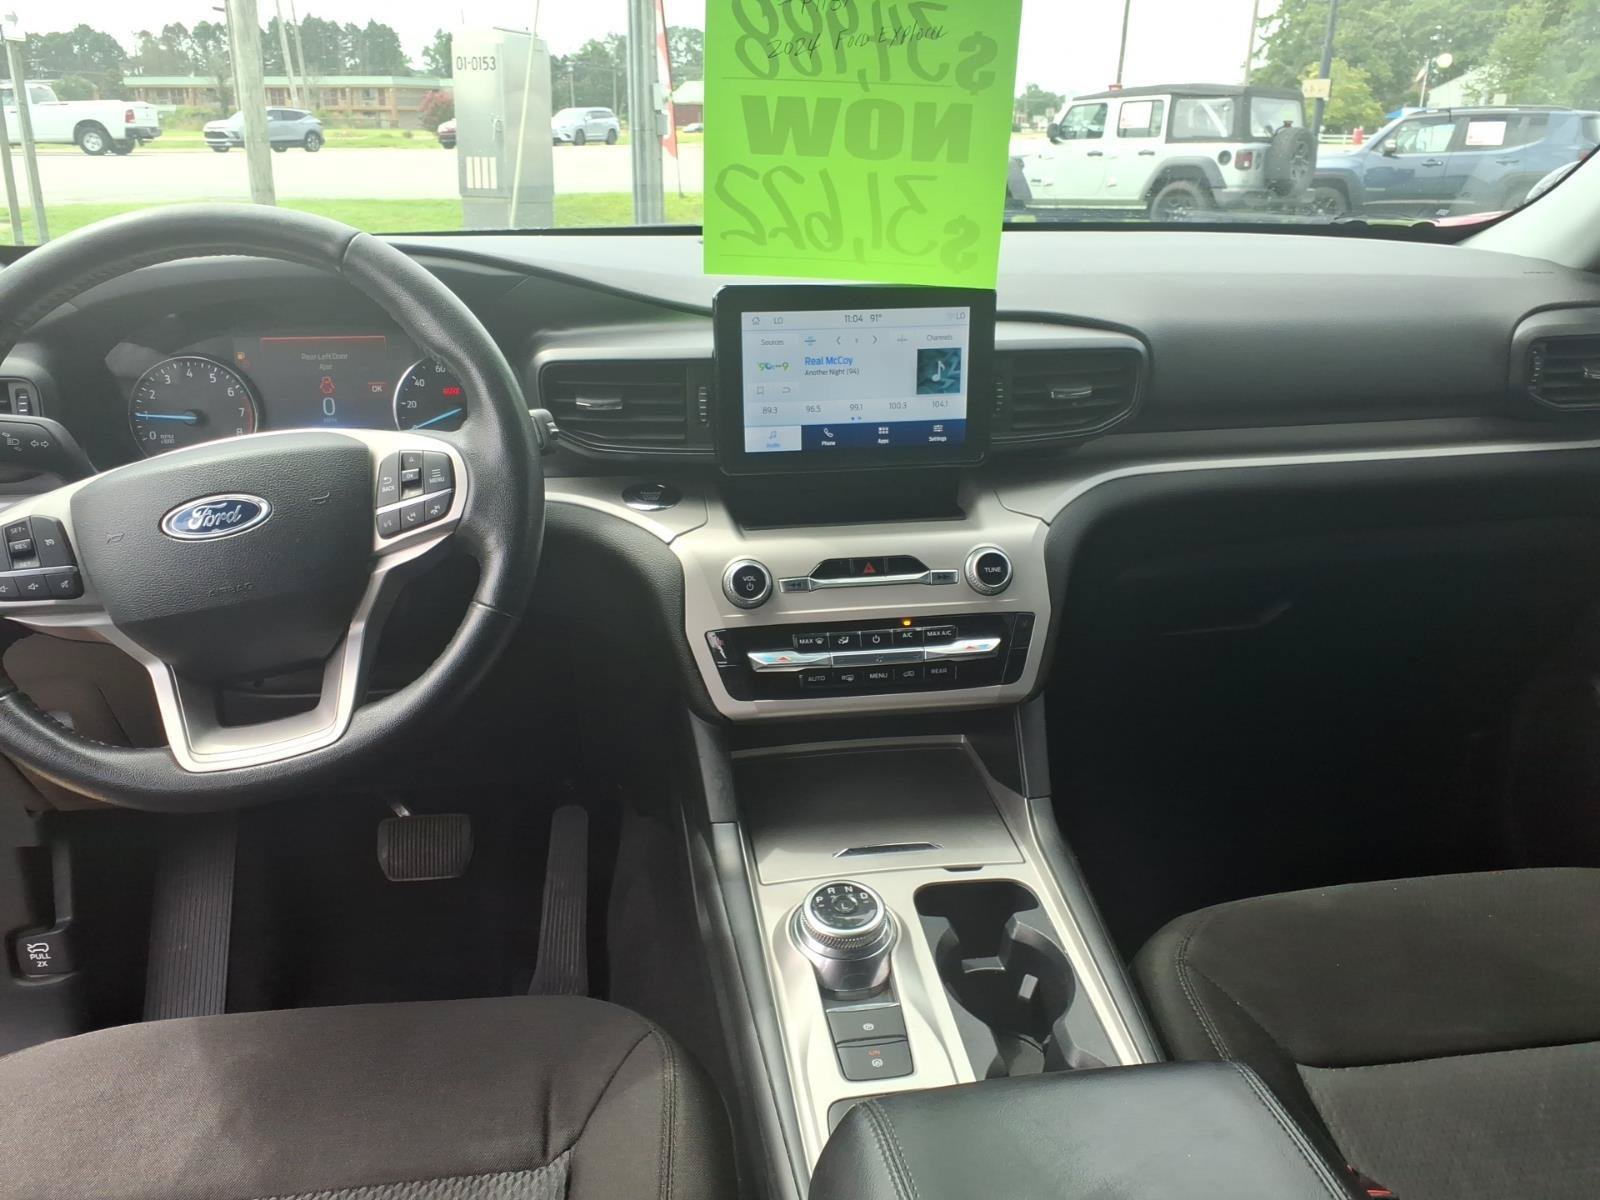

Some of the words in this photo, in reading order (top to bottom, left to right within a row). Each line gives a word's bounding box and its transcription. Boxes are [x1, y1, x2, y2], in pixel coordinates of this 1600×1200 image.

[767, 33, 821, 59] 2024
[456, 56, 497, 71] 01-0153
[844, 314, 863, 323] 11:04
[760, 338, 785, 346] Sources
[804, 356, 824, 366] Real
[825, 355, 854, 367] McCoy
[186, 369, 194, 379] 4
[804, 369, 828, 377] Another
[829, 368, 845, 377] Night
[164, 375, 172, 385] 3
[208, 373, 217, 384] 5
[413, 378, 426, 388] 40
[148, 389, 157, 400] 2
[226, 387, 235, 398] 6
[322, 397, 336, 417] 0
[406, 400, 418, 409] 20
[849, 403, 863, 411] 99.1
[889, 402, 908, 410] 100.3
[932, 400, 949, 409] 104.1
[238, 407, 246, 417] 7
[761, 406, 779, 415] 89.3
[149, 430, 157, 441] 0
[381, 485, 395, 493] BACK
[187, 502, 242, 530] Ford
[799, 637, 813, 645] MAX
[36, 960, 48, 968] 2X
